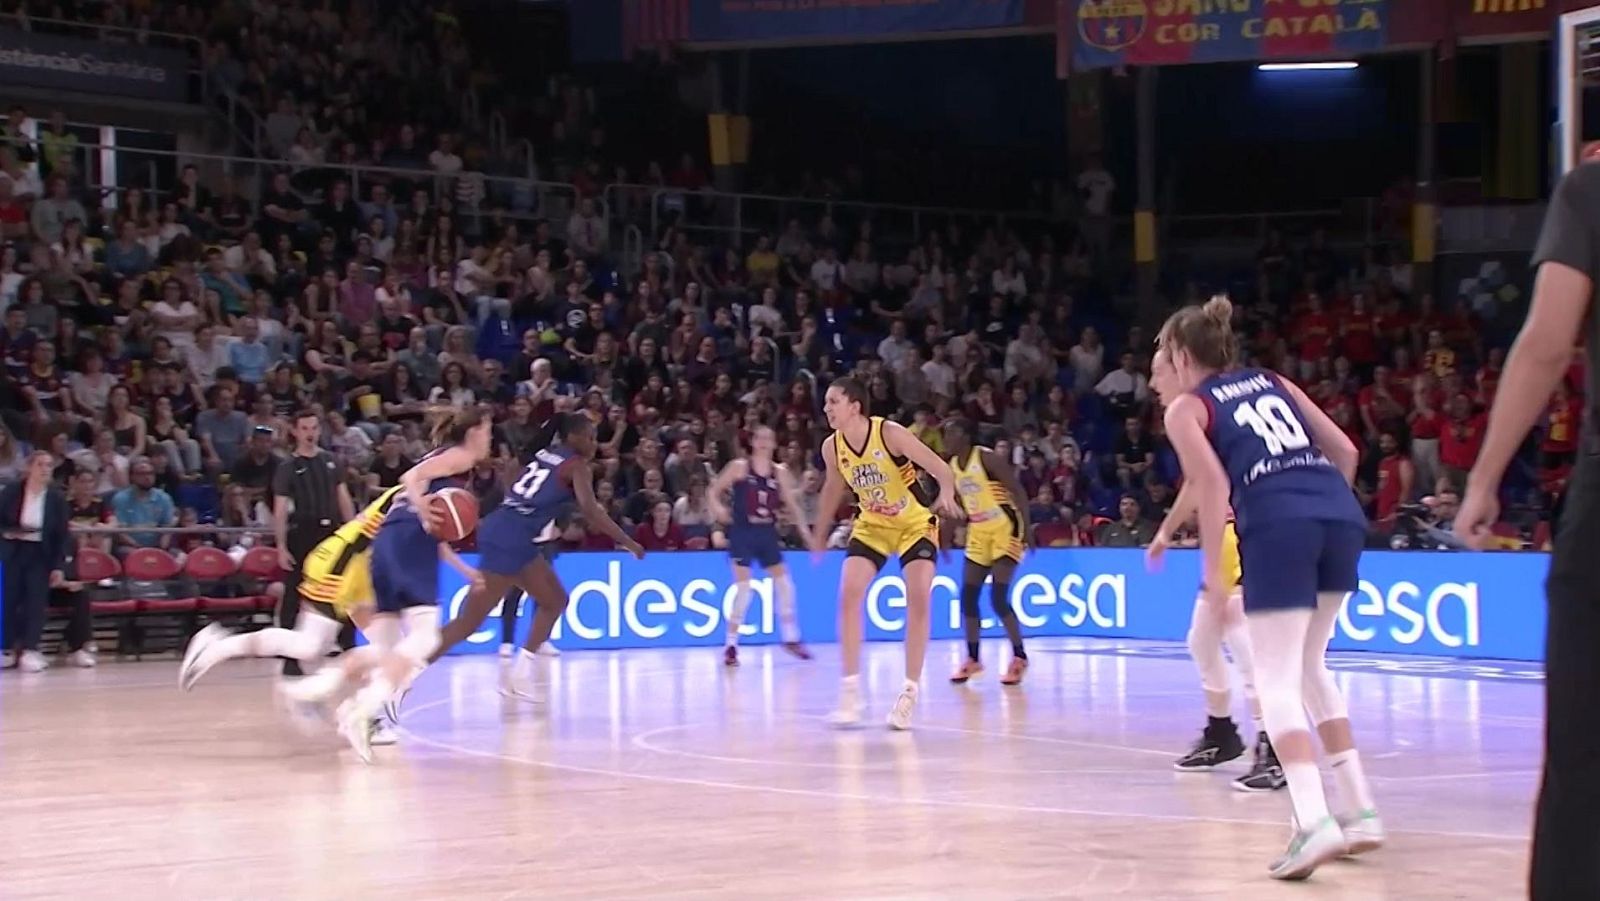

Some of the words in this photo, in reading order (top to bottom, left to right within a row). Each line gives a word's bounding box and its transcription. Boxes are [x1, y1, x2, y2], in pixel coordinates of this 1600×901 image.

[1154, 22, 1220, 44] COR
[1241, 7, 1381, 39] CATALÀ
[1233, 394, 1311, 456] 10
[512, 460, 551, 500] 21
[450, 560, 774, 643] desa
[866, 573, 1127, 631] enesa
[1334, 579, 1479, 647] esa
